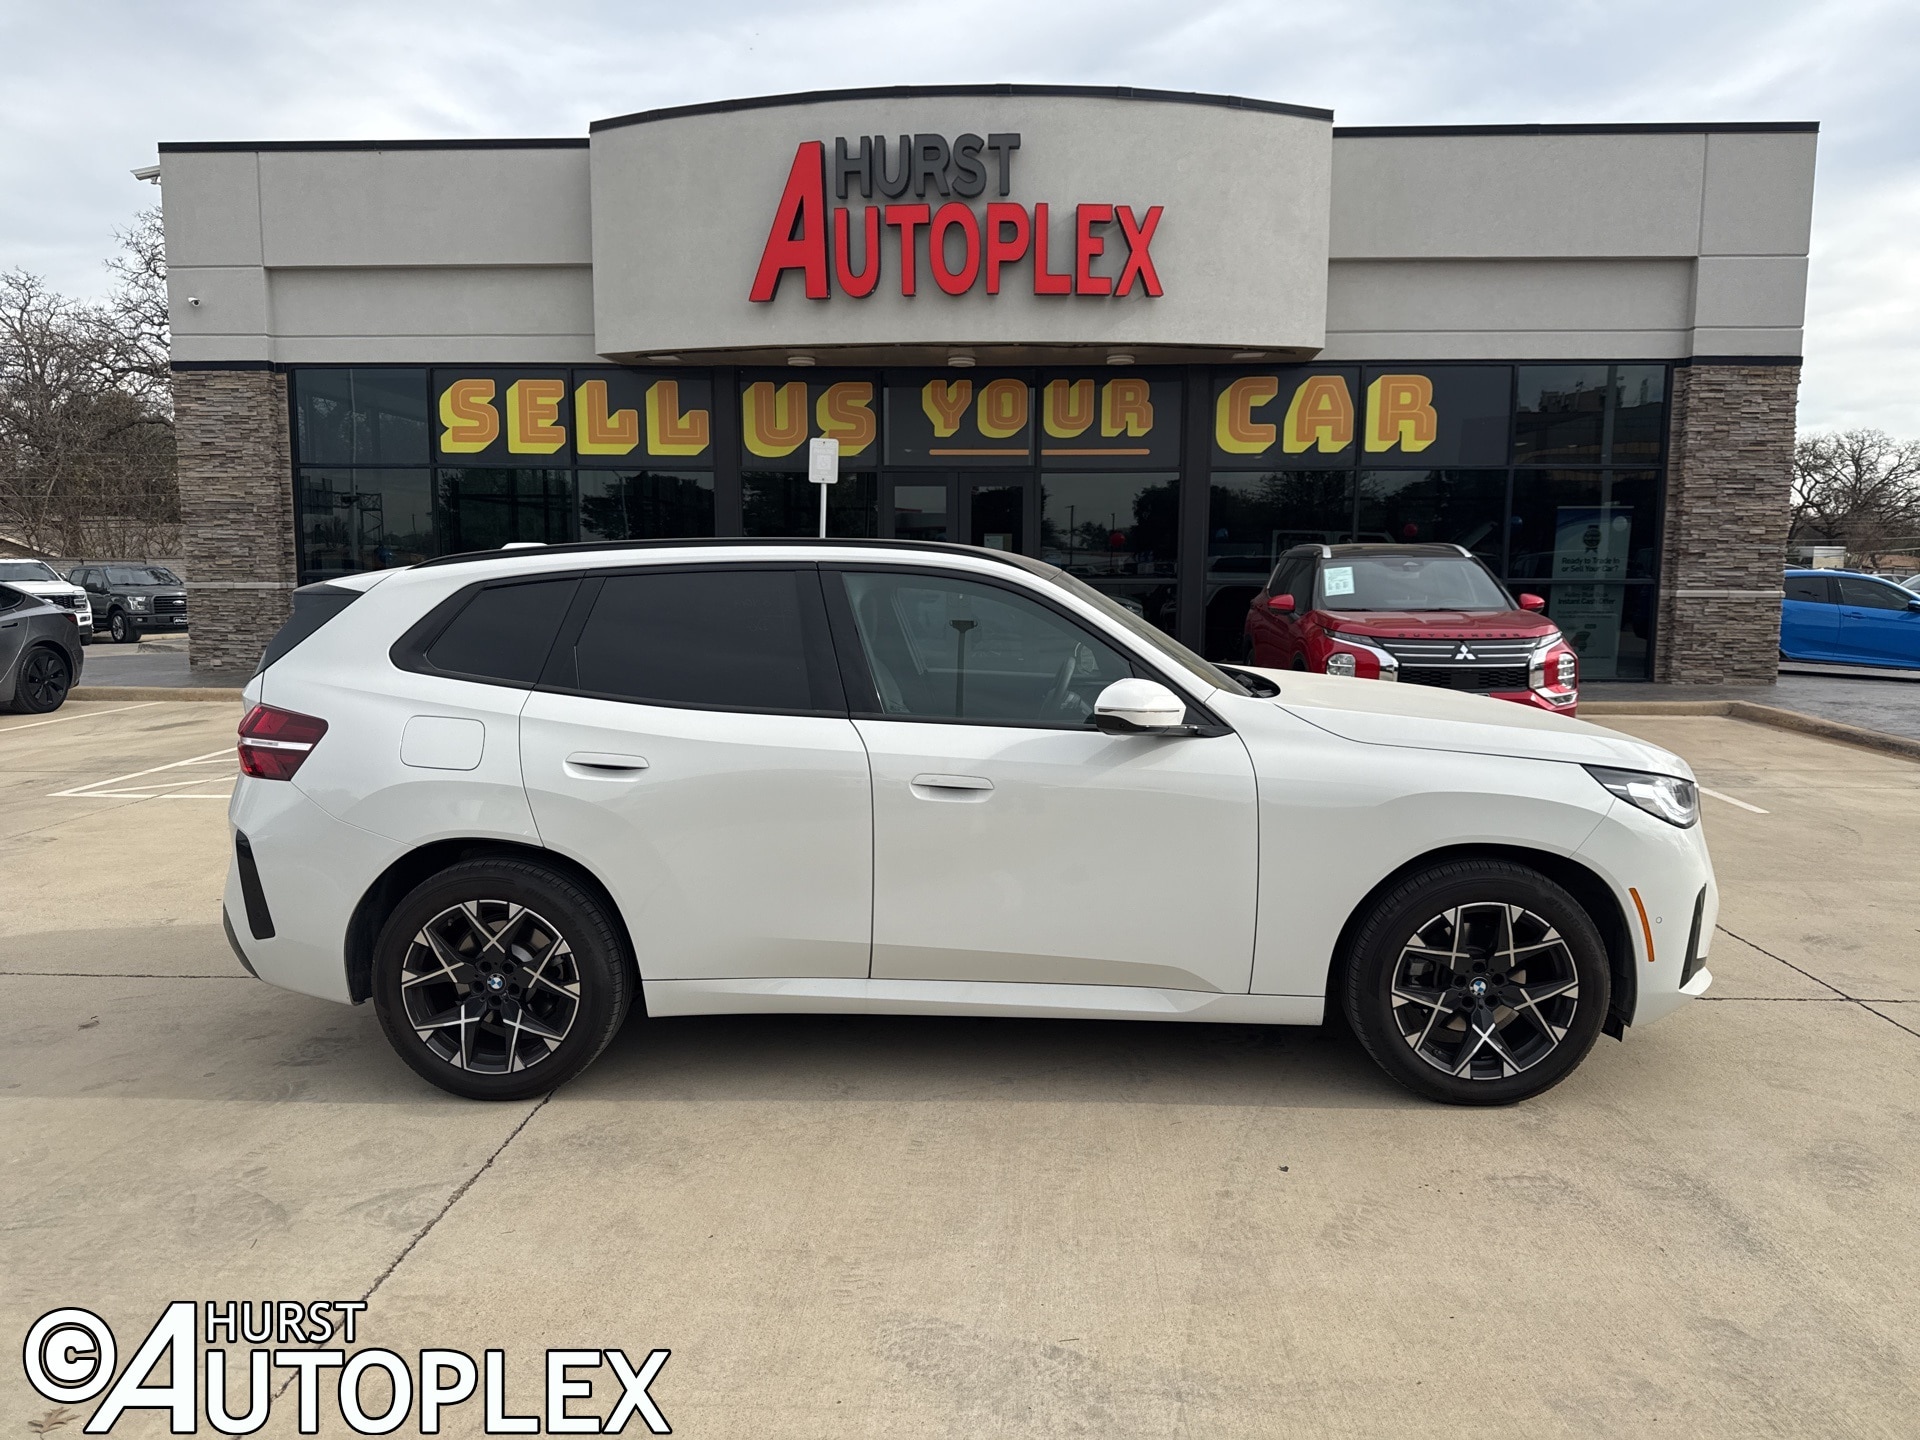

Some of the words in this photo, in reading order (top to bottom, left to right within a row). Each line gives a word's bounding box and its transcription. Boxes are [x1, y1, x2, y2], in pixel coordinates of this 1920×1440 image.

[835, 133, 1021, 199] HURST
[749, 141, 1164, 302] AUTOPLEX
[439, 378, 710, 456] SELL
[742, 381, 877, 458] US
[921, 378, 1153, 438] YOUR
[1215, 374, 1438, 453] CAR
[1561, 557, 1583, 566] Ready
